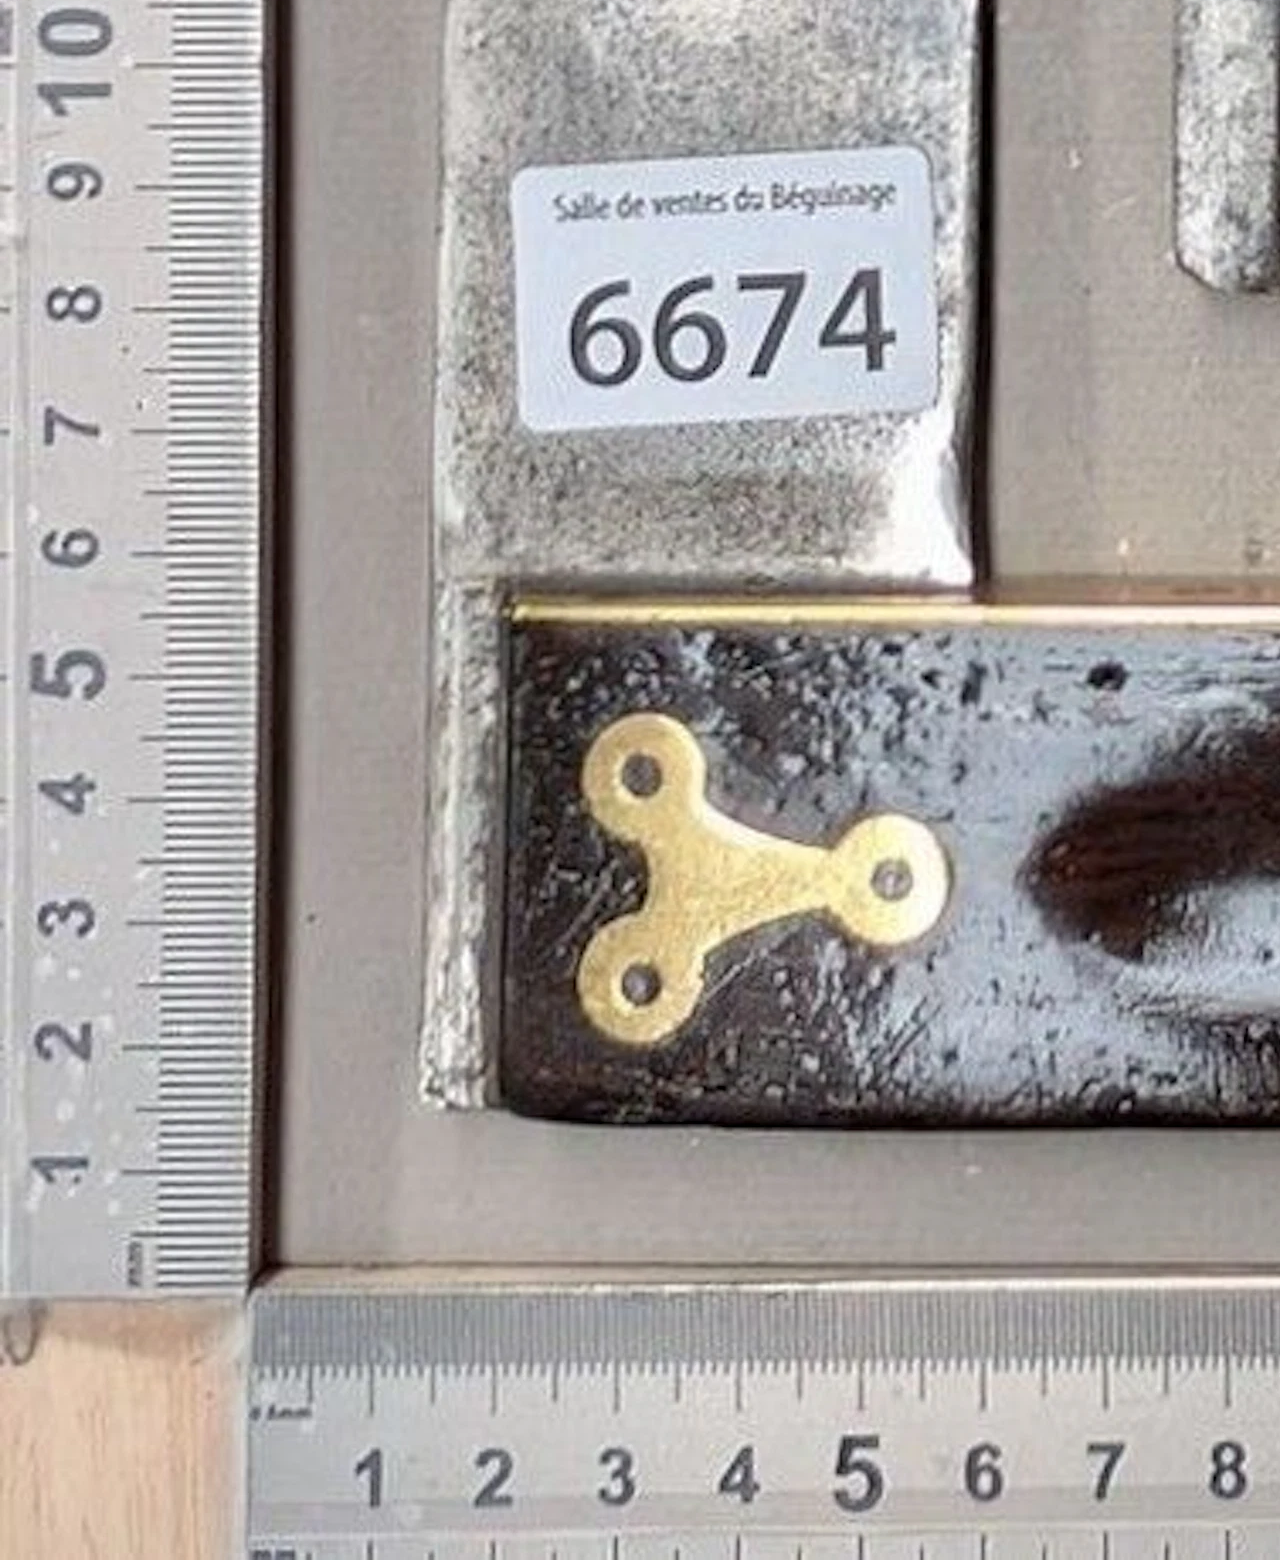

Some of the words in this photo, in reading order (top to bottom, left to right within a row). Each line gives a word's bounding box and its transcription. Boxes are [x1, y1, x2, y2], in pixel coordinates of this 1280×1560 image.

[38, 8, 113, 116] 10
[46, 162, 101, 200] 9
[553, 191, 611, 222] Salle
[615, 190, 648, 219] de
[651, 189, 728, 215] ventes
[734, 184, 764, 212] du
[770, 181, 897, 215] Béguinage
[46, 287, 101, 323] 8
[568, 267, 897, 388] 6674
[44, 406, 100, 445] 7
[41, 528, 100, 568] 6
[29, 650, 106, 700] 5
[38, 773, 96, 814] 4
[37, 898, 95, 938] 3
[34, 1022, 92, 1062] 2
[31, 1156, 89, 1183] 1
[355, 1448, 384, 1508] 1
[473, 1448, 514, 1508] 2
[598, 1448, 636, 1506] 3
[719, 1446, 760, 1503] 4
[834, 1435, 884, 1512] 5
[964, 1443, 1002, 1501] 6
[1087, 1443, 1126, 1499] 7
[1209, 1442, 1247, 1499] 8
